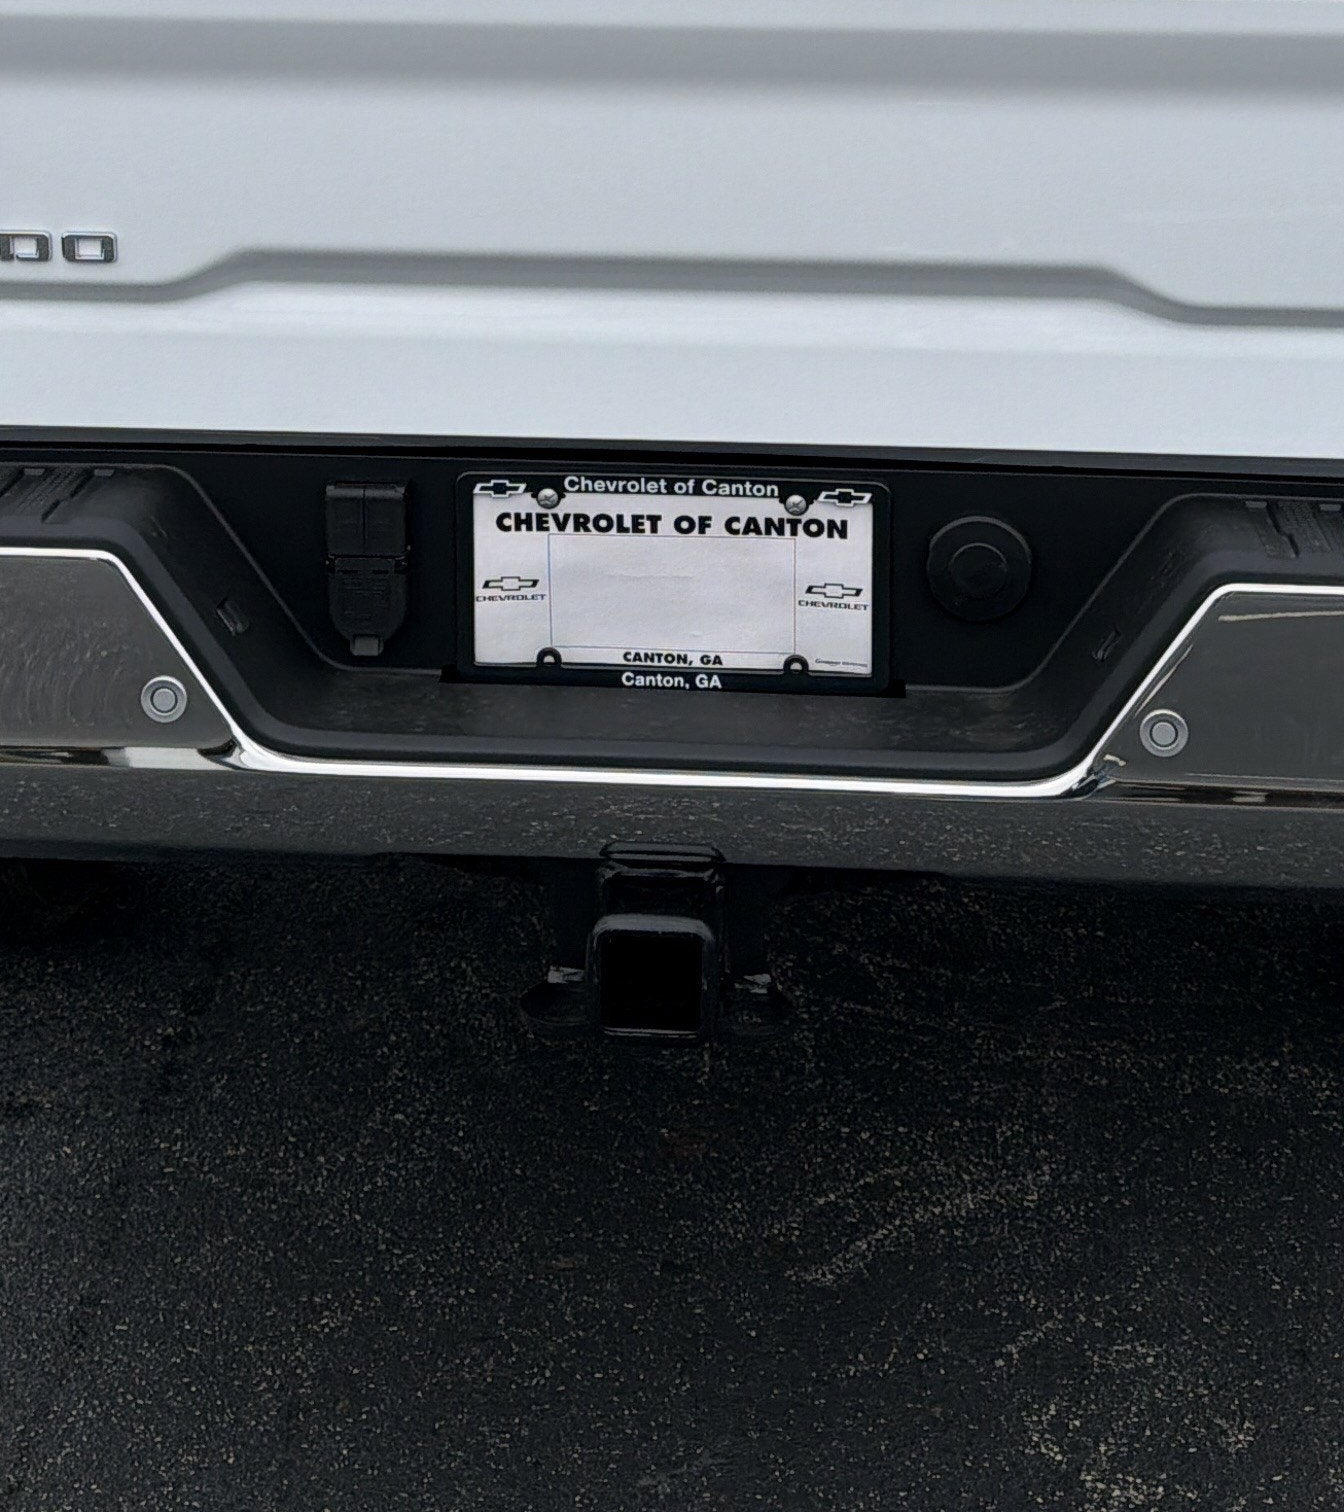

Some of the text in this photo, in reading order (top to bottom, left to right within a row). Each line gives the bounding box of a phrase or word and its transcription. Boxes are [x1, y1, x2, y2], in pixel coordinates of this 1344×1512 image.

[564, 476, 780, 498] Chevrolet of Canton
[495, 512, 849, 540] CHEVROLET OF CANTON
[475, 593, 547, 603] CHEVROLET
[798, 599, 870, 611] CHEVROLET
[622, 651, 723, 667] CANTON, GA
[621, 671, 723, 690] Canton, GA
